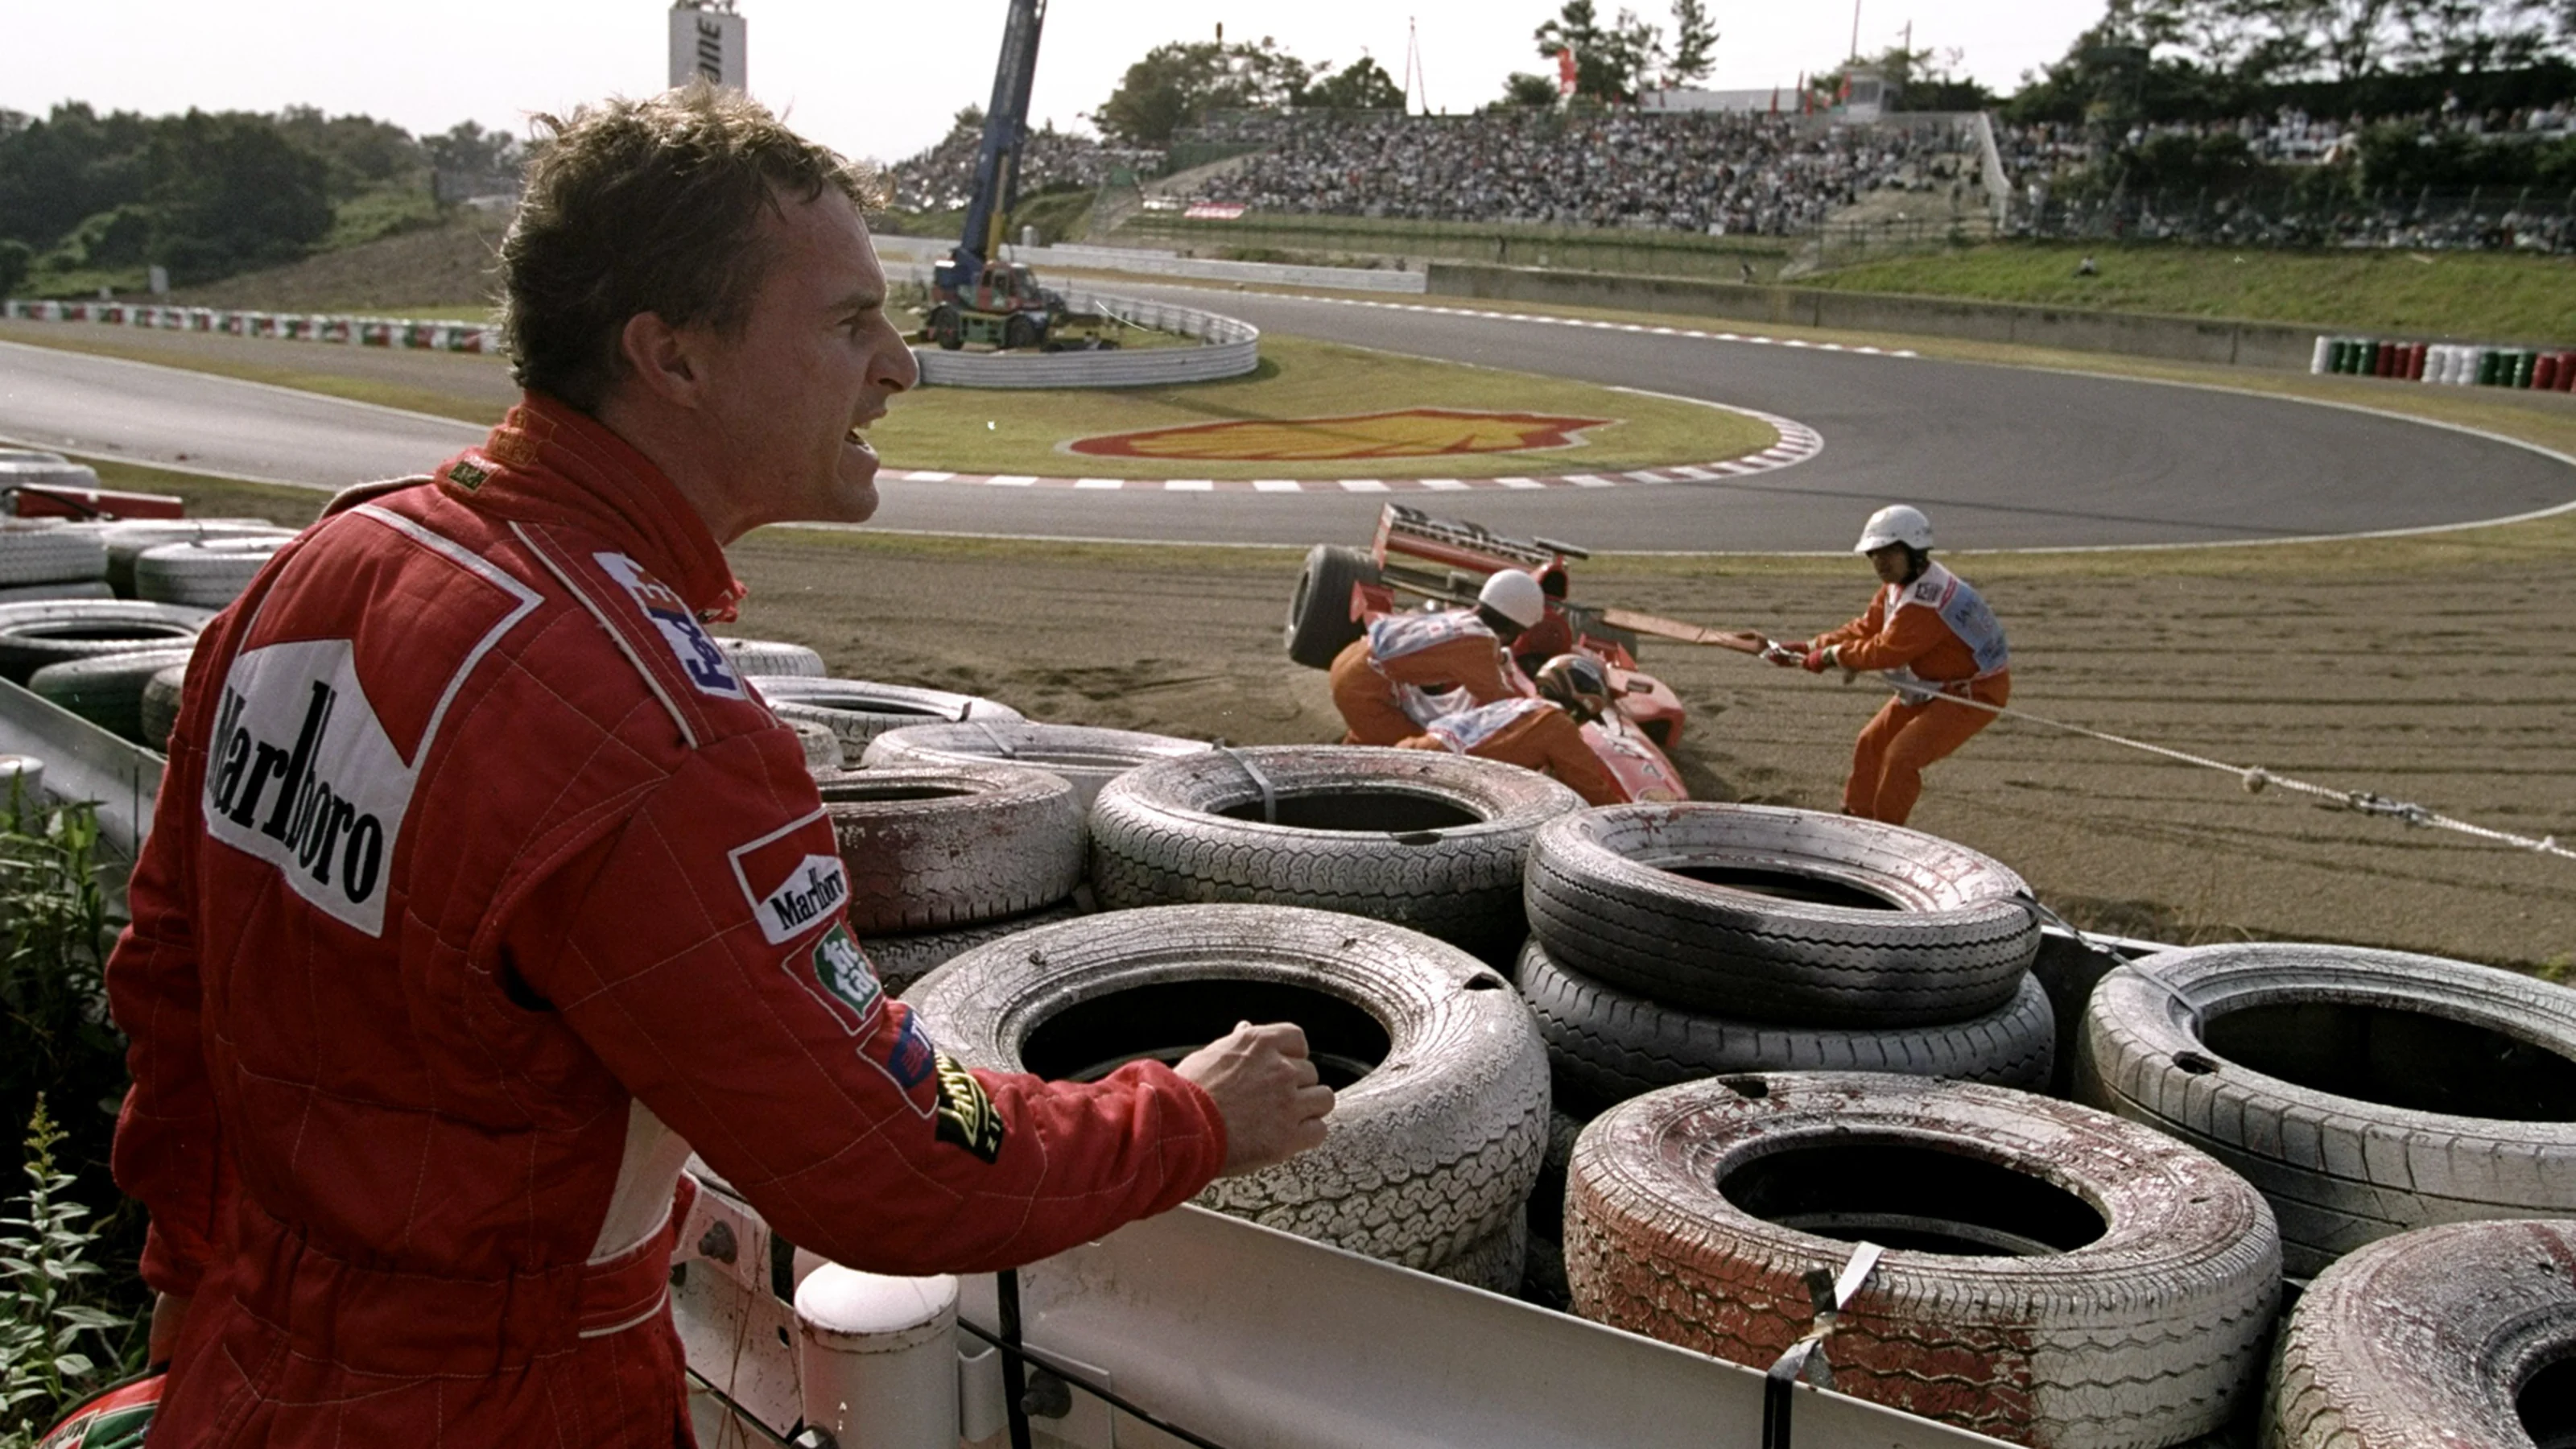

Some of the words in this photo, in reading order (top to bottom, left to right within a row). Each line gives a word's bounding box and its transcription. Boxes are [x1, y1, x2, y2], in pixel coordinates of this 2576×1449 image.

[207, 680, 383, 904] Marlboro
[824, 938, 859, 975] tic
[834, 961, 877, 1002] tac
